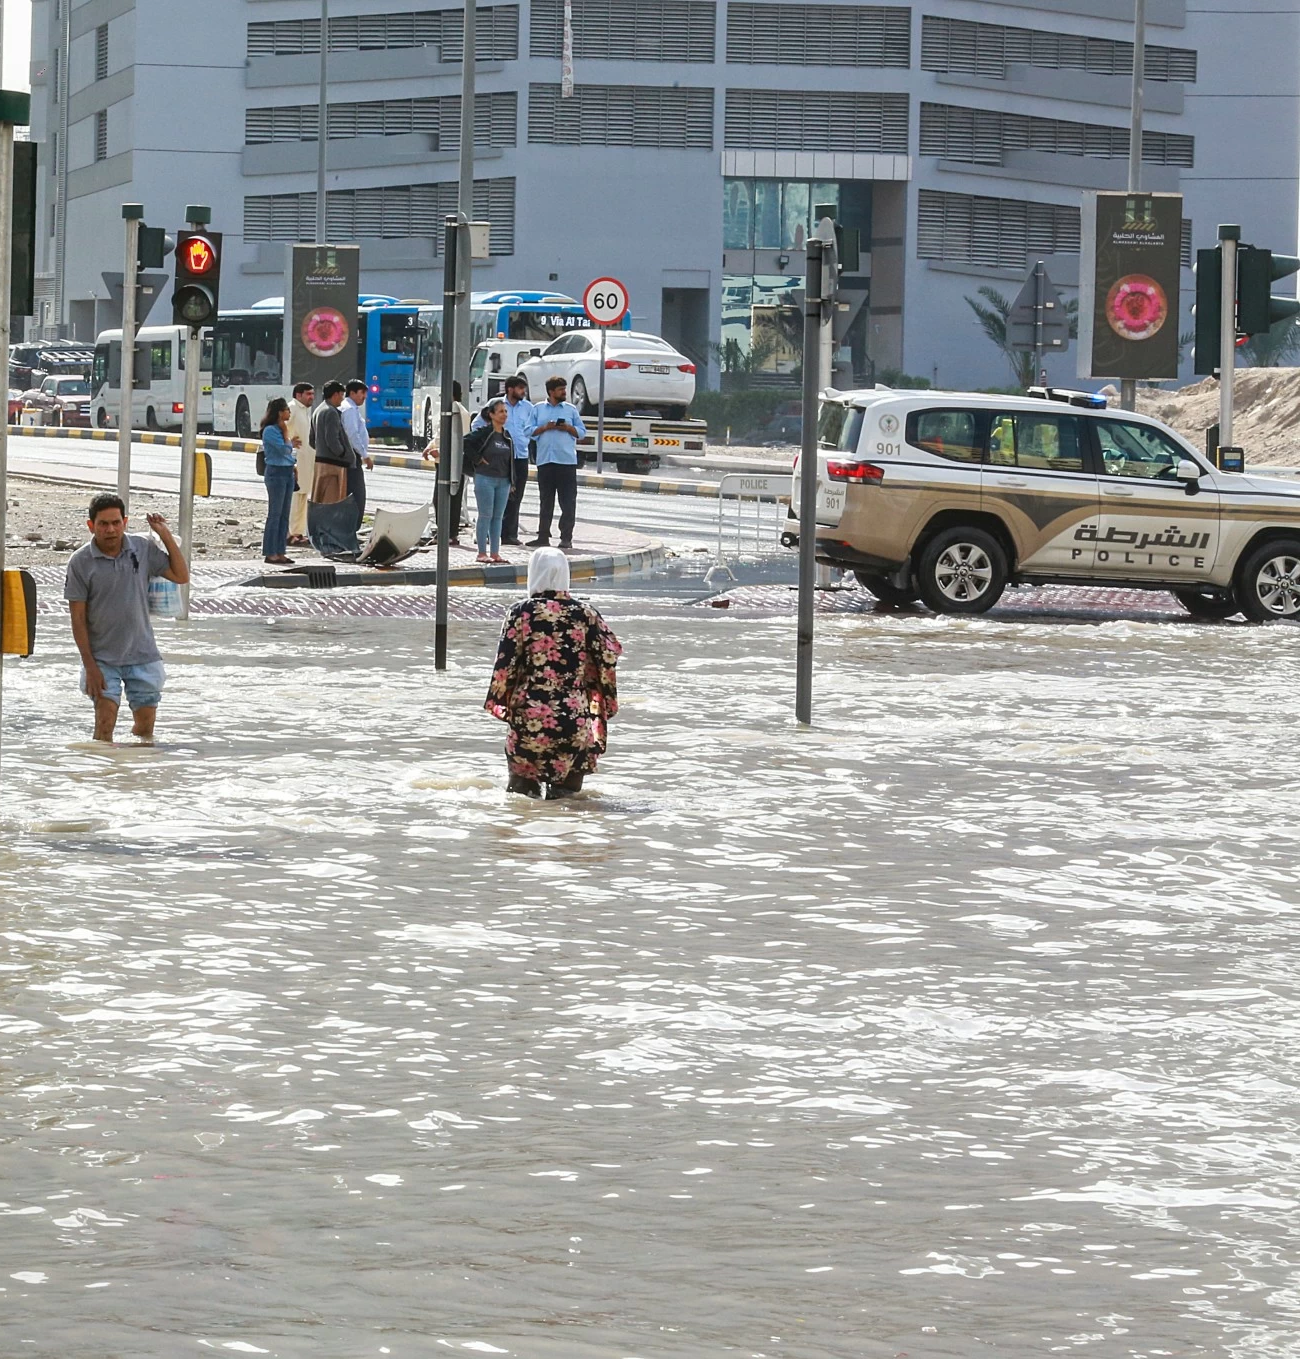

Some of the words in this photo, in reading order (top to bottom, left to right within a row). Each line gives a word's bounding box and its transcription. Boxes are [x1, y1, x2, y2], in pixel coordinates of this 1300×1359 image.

[594, 293, 618, 309] 60
[550, 315, 564, 326] Via
[566, 317, 575, 326] Al
[876, 442, 901, 456] 901
[740, 479, 768, 490] POLICE
[826, 497, 840, 510] 901
[1074, 524, 1210, 549] الشرطة
[1071, 548, 1205, 568] POLICE
